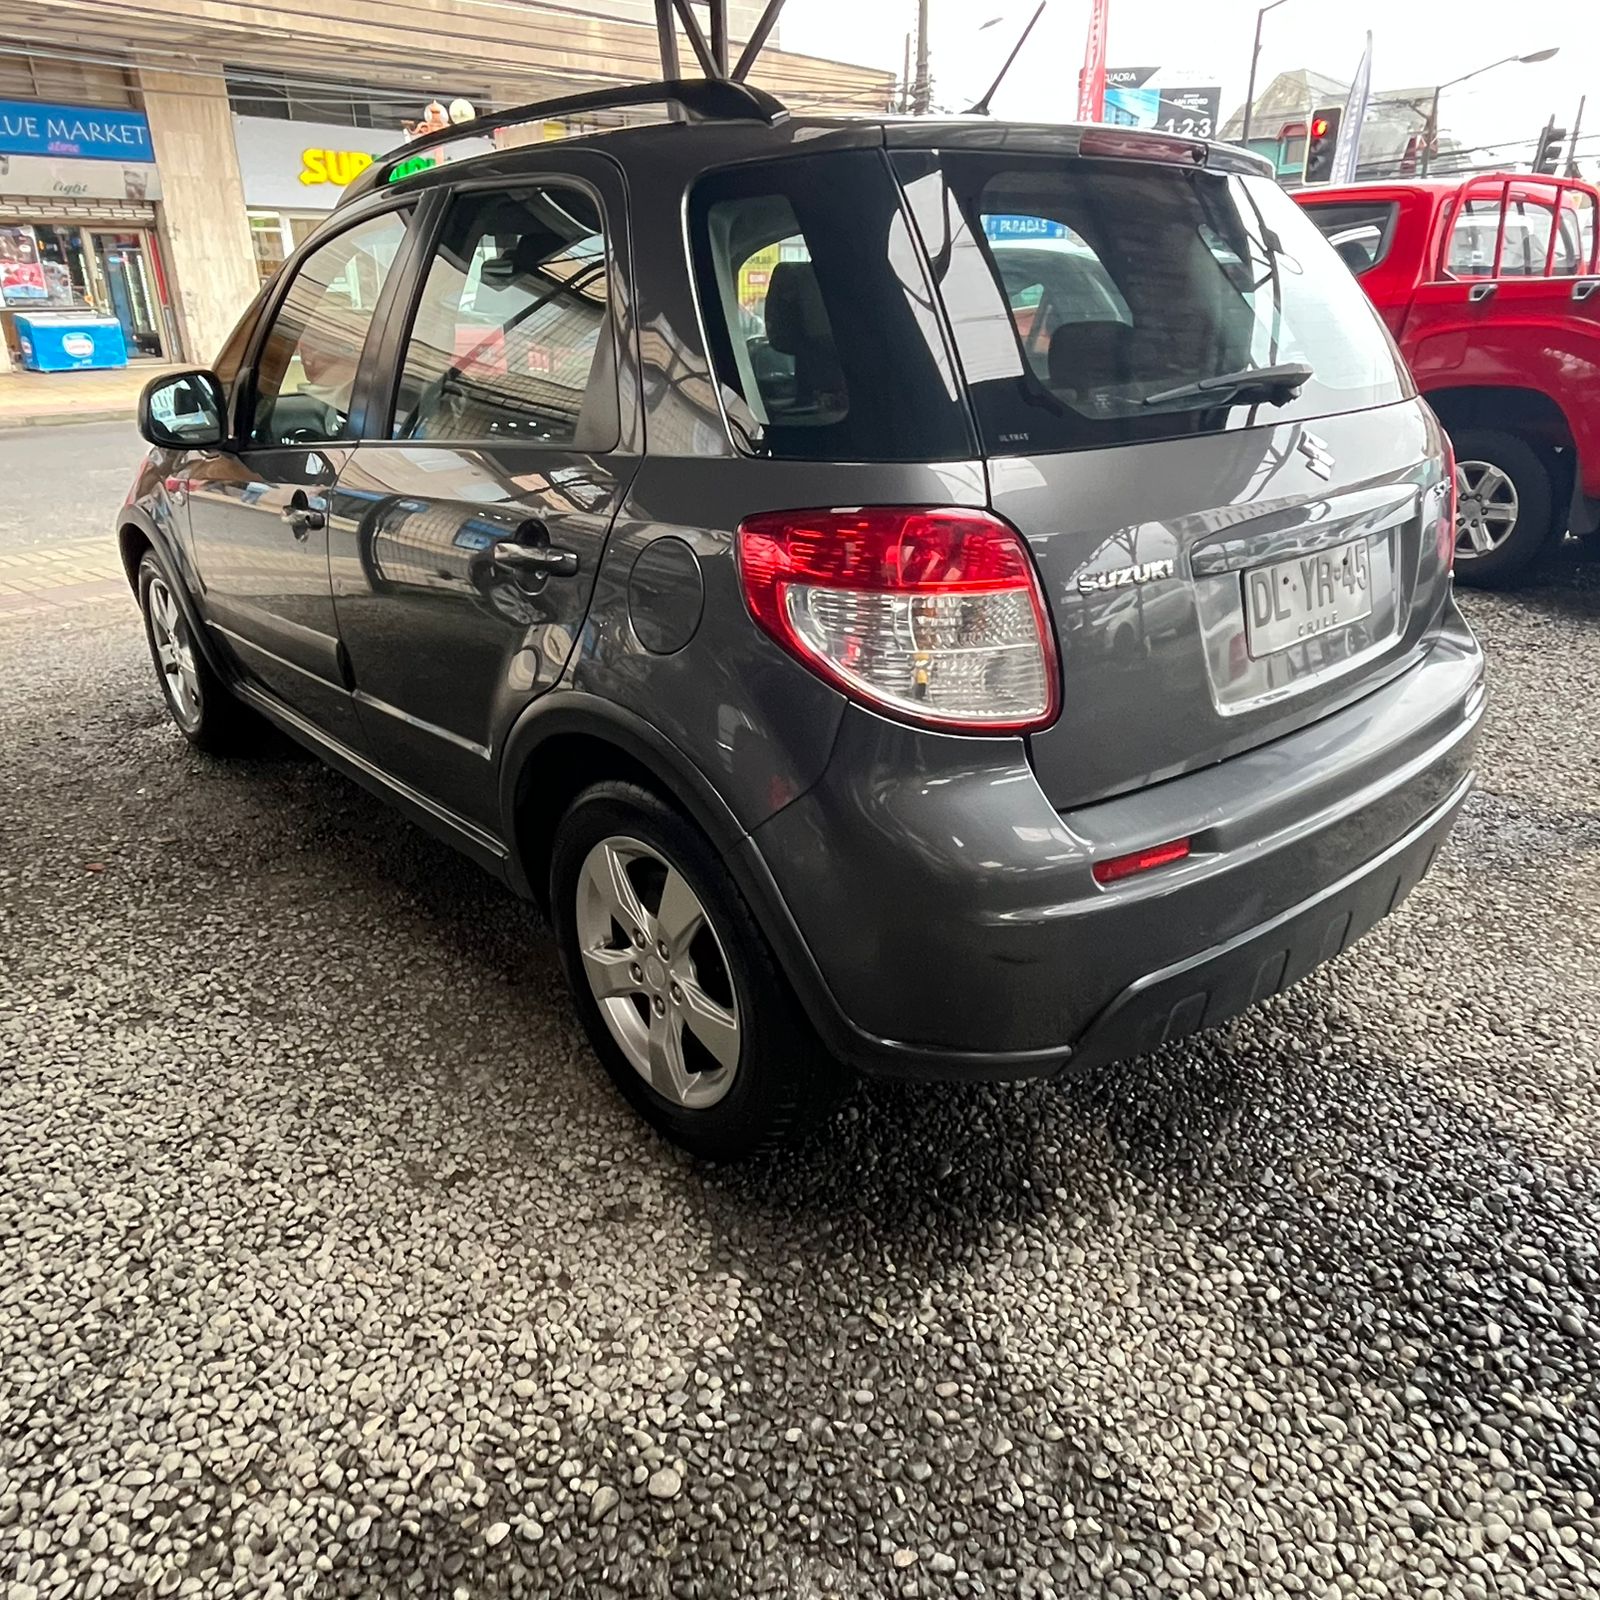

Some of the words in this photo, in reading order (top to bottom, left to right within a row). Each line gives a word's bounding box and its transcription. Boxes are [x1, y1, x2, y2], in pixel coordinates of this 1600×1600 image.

[0, 116, 40, 137] UE
[48, 119, 146, 144] MARKET
[1078, 559, 1174, 595] SUZUKI
[1298, 610, 1338, 636] CHILE
